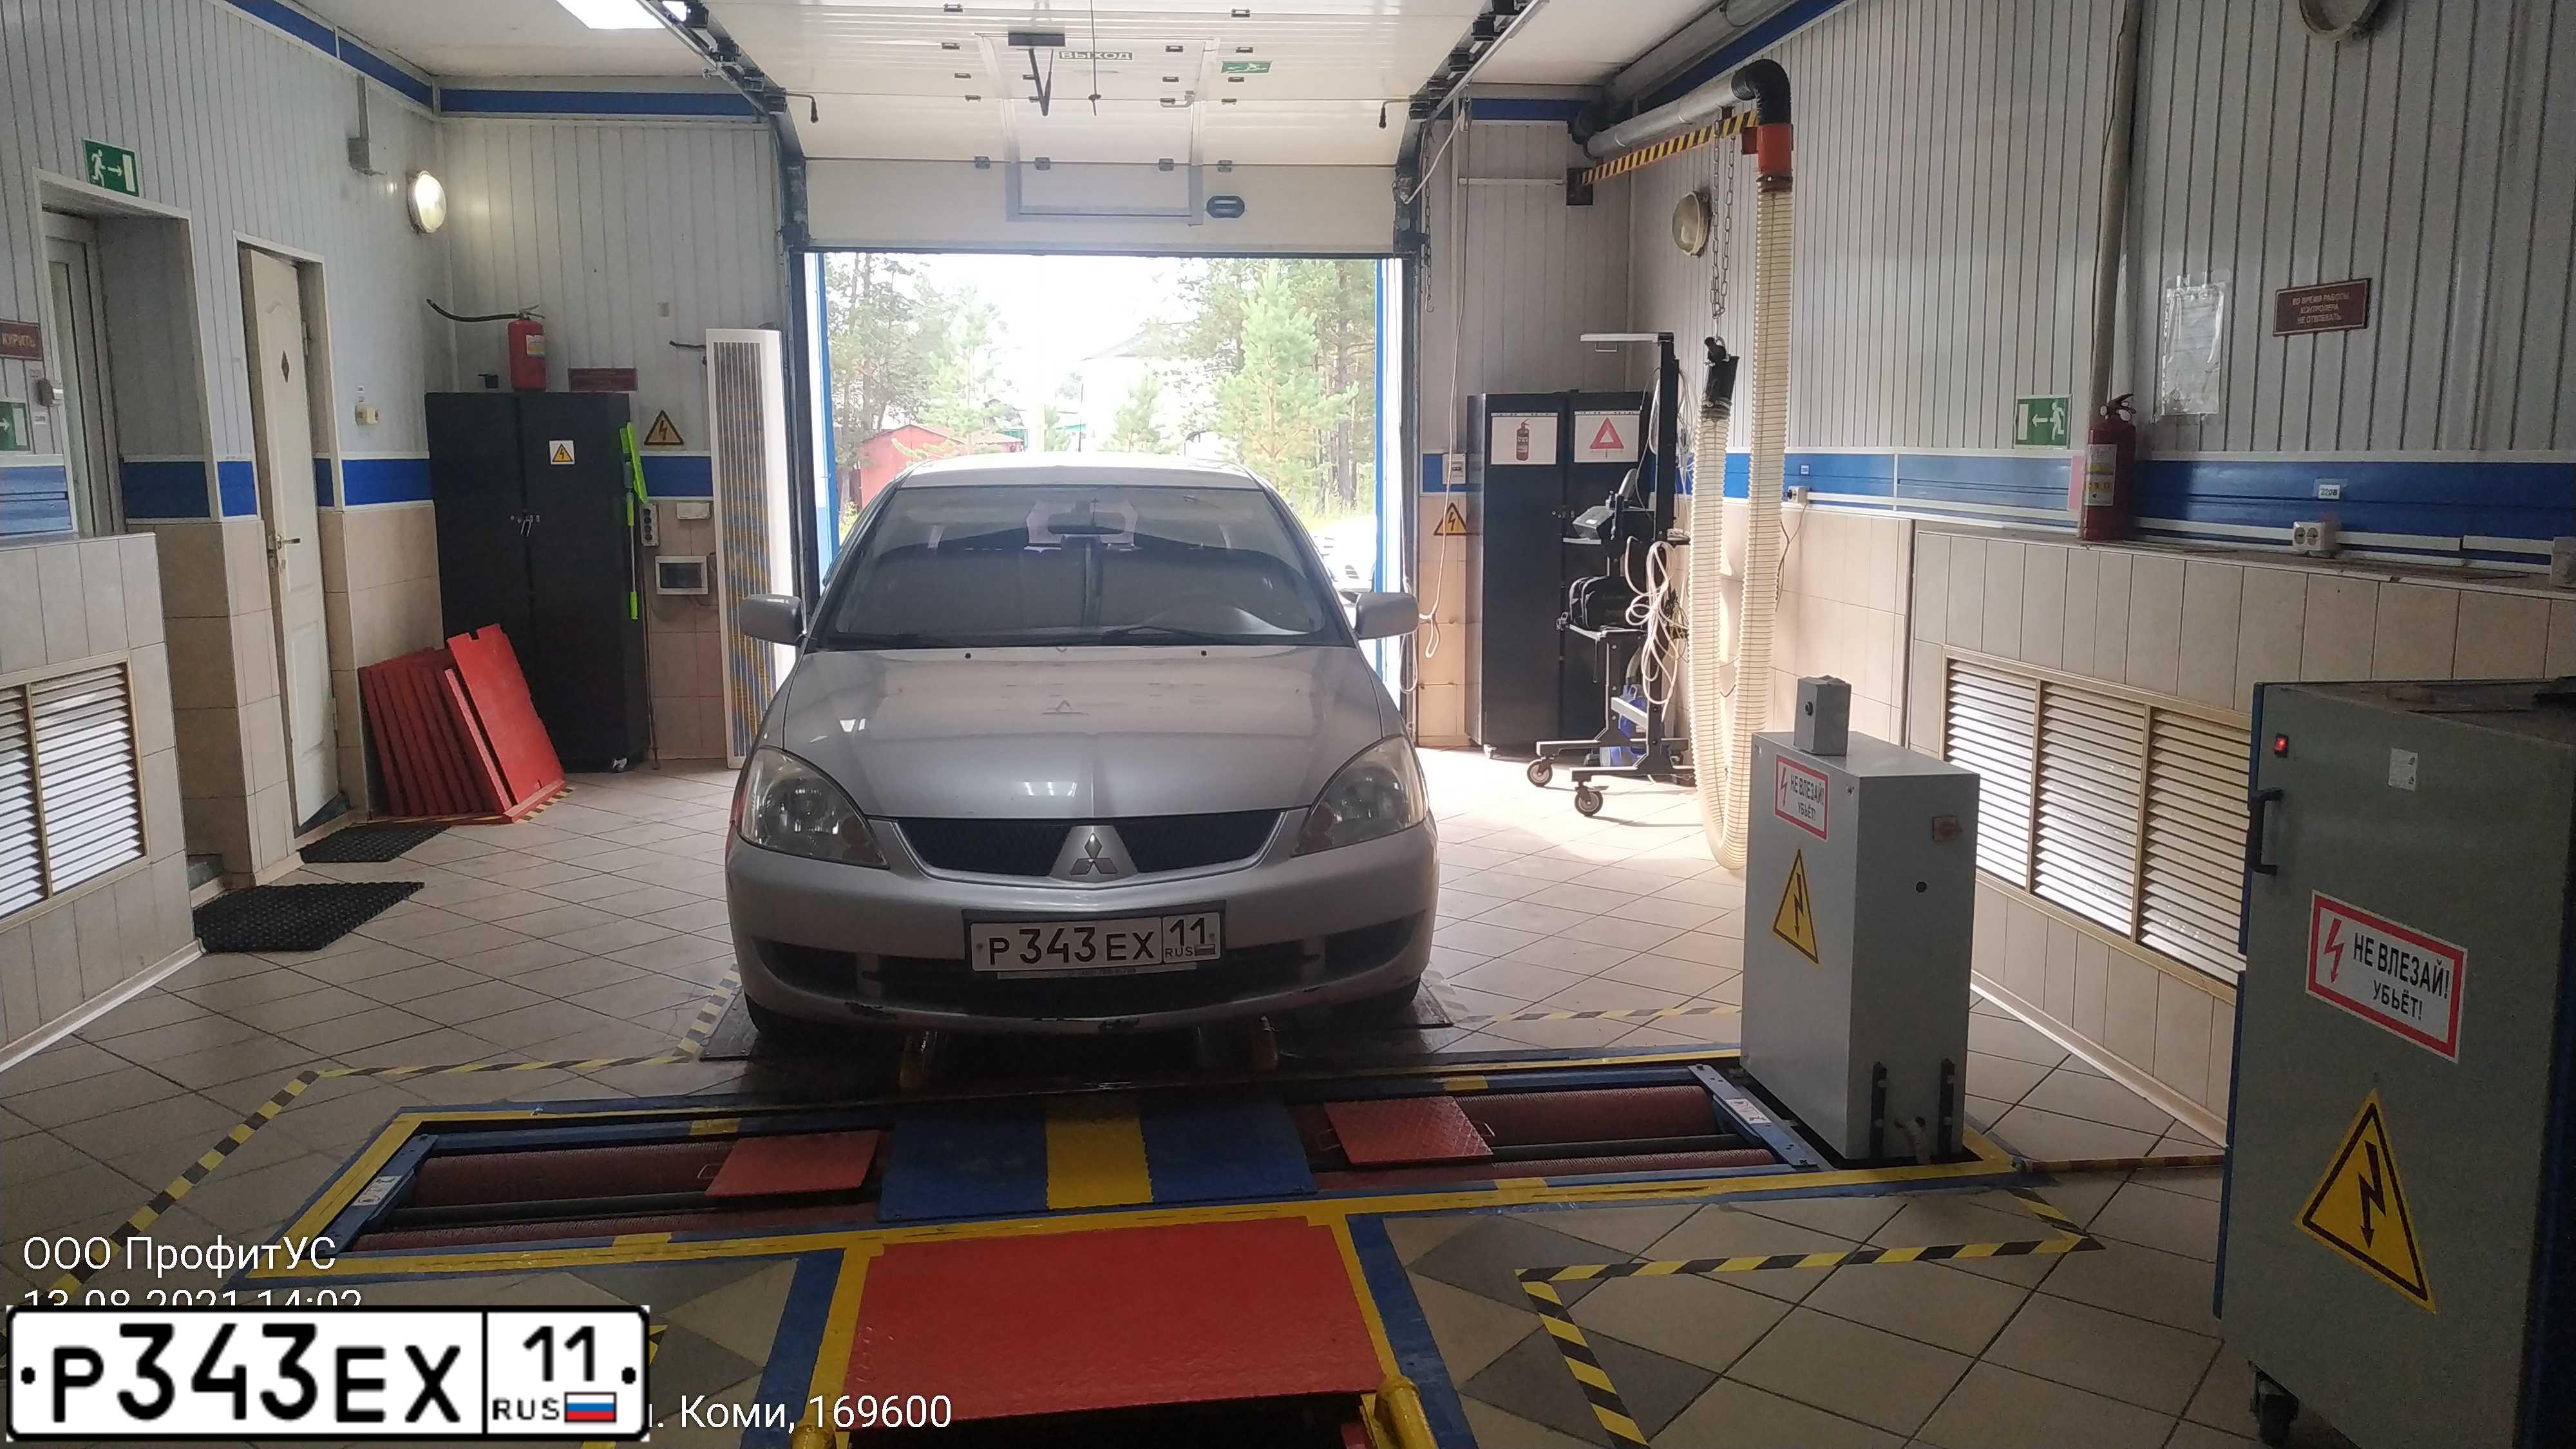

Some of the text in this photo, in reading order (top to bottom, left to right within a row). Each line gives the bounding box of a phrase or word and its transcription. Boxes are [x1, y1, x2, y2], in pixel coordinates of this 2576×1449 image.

[1790, 773, 1798, 793] НЕ
[1169, 917, 1206, 946] 11
[1164, 947, 1193, 958] RUS
[2353, 932, 2450, 999] НЕ ВЛЕЗАЙ!
[2372, 979, 2423, 1021] УБЬЁТ!
